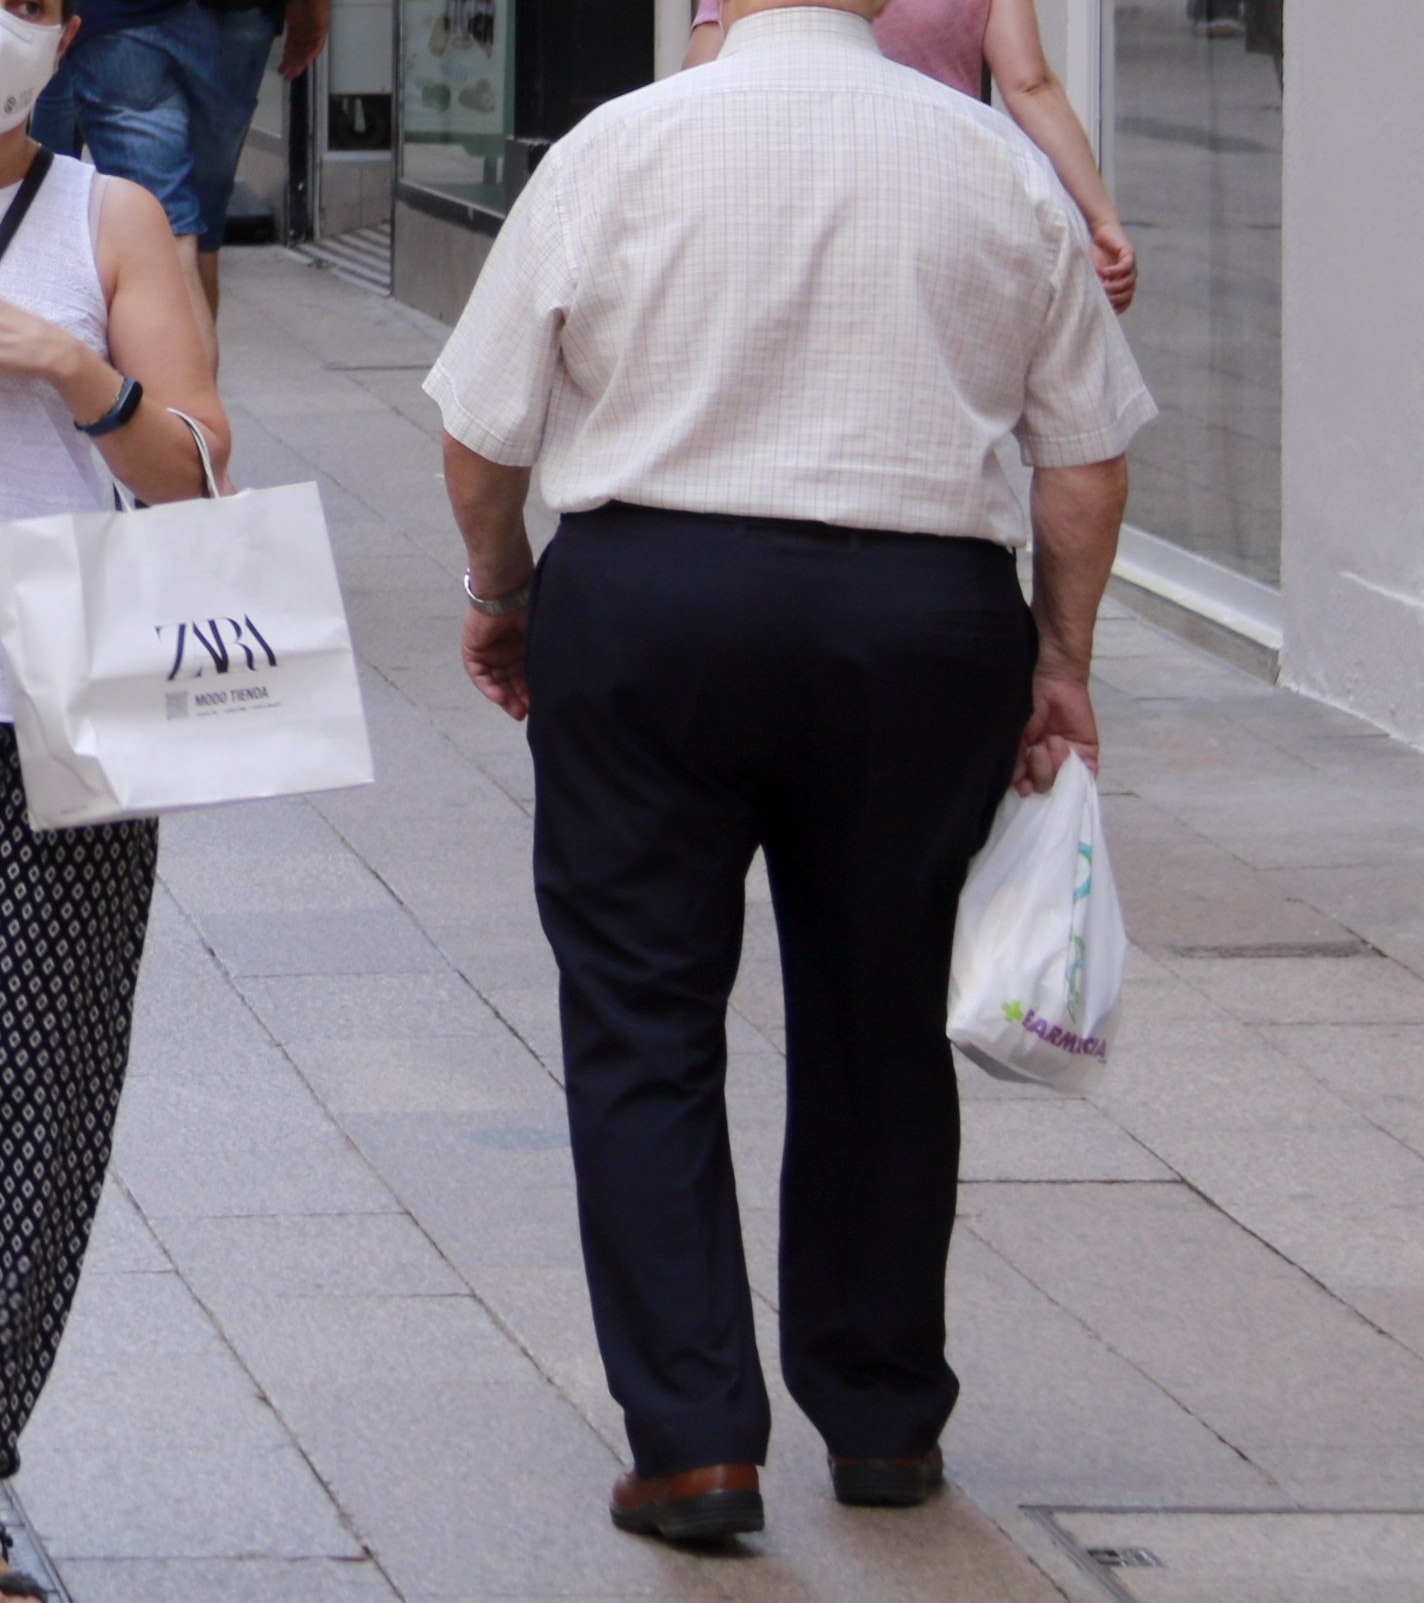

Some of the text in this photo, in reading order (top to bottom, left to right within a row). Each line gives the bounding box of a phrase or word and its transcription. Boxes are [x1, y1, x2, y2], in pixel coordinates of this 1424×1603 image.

[153, 611, 280, 682] ZARA
[194, 685, 270, 708] MODO TIENDA
